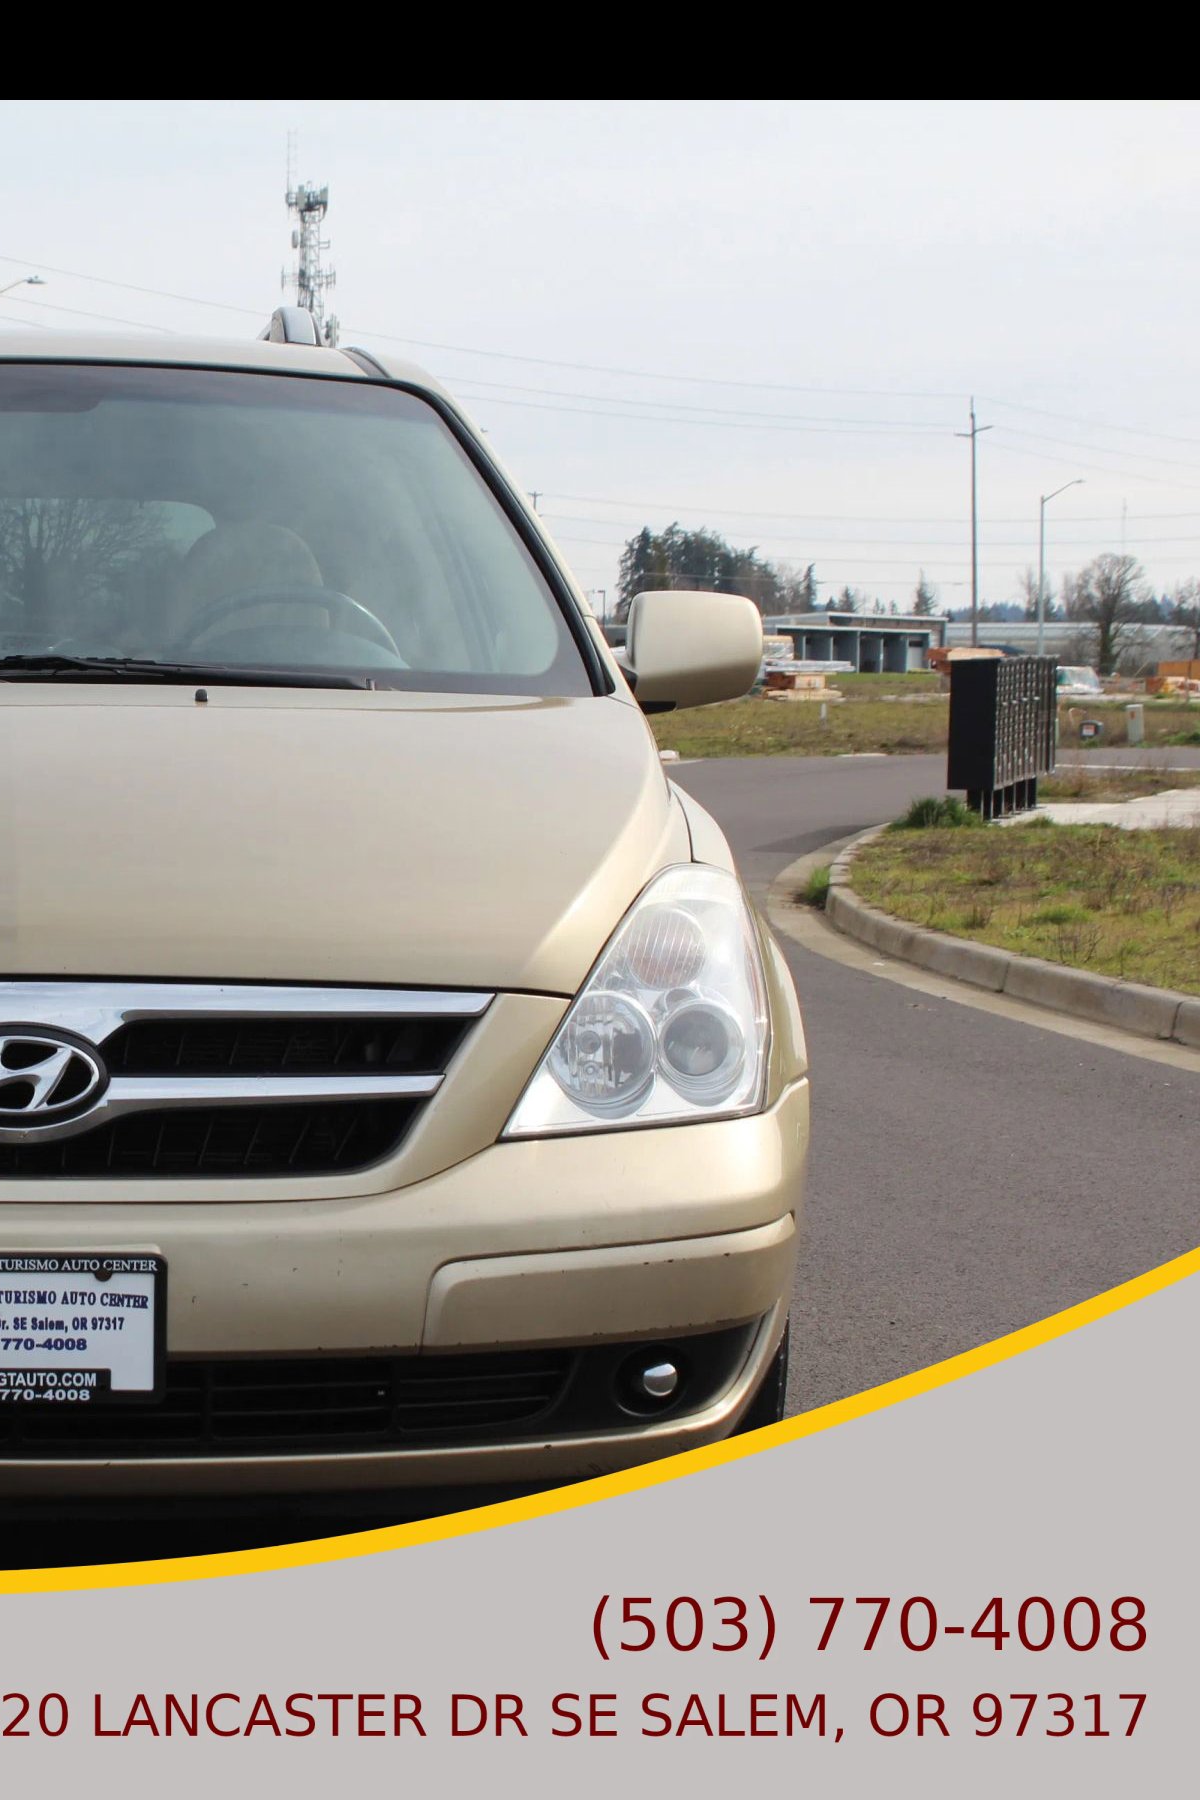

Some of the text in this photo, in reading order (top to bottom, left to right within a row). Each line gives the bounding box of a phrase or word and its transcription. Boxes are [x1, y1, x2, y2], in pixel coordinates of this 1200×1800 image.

[61, 1259, 100, 1271] AUTO
[103, 1259, 158, 1271] CENTER
[60, 1291, 97, 1306] AUTO
[100, 1292, 149, 1309] CENTER
[13, 1316, 28, 1330] SE
[31, 1316, 69, 1333] Salem,
[72, 1316, 88, 1331] OR
[91, 1316, 125, 1331] 97317
[0, 1338, 87, 1351] 770-4008
[0, 1388, 90, 1401] 770-4008
